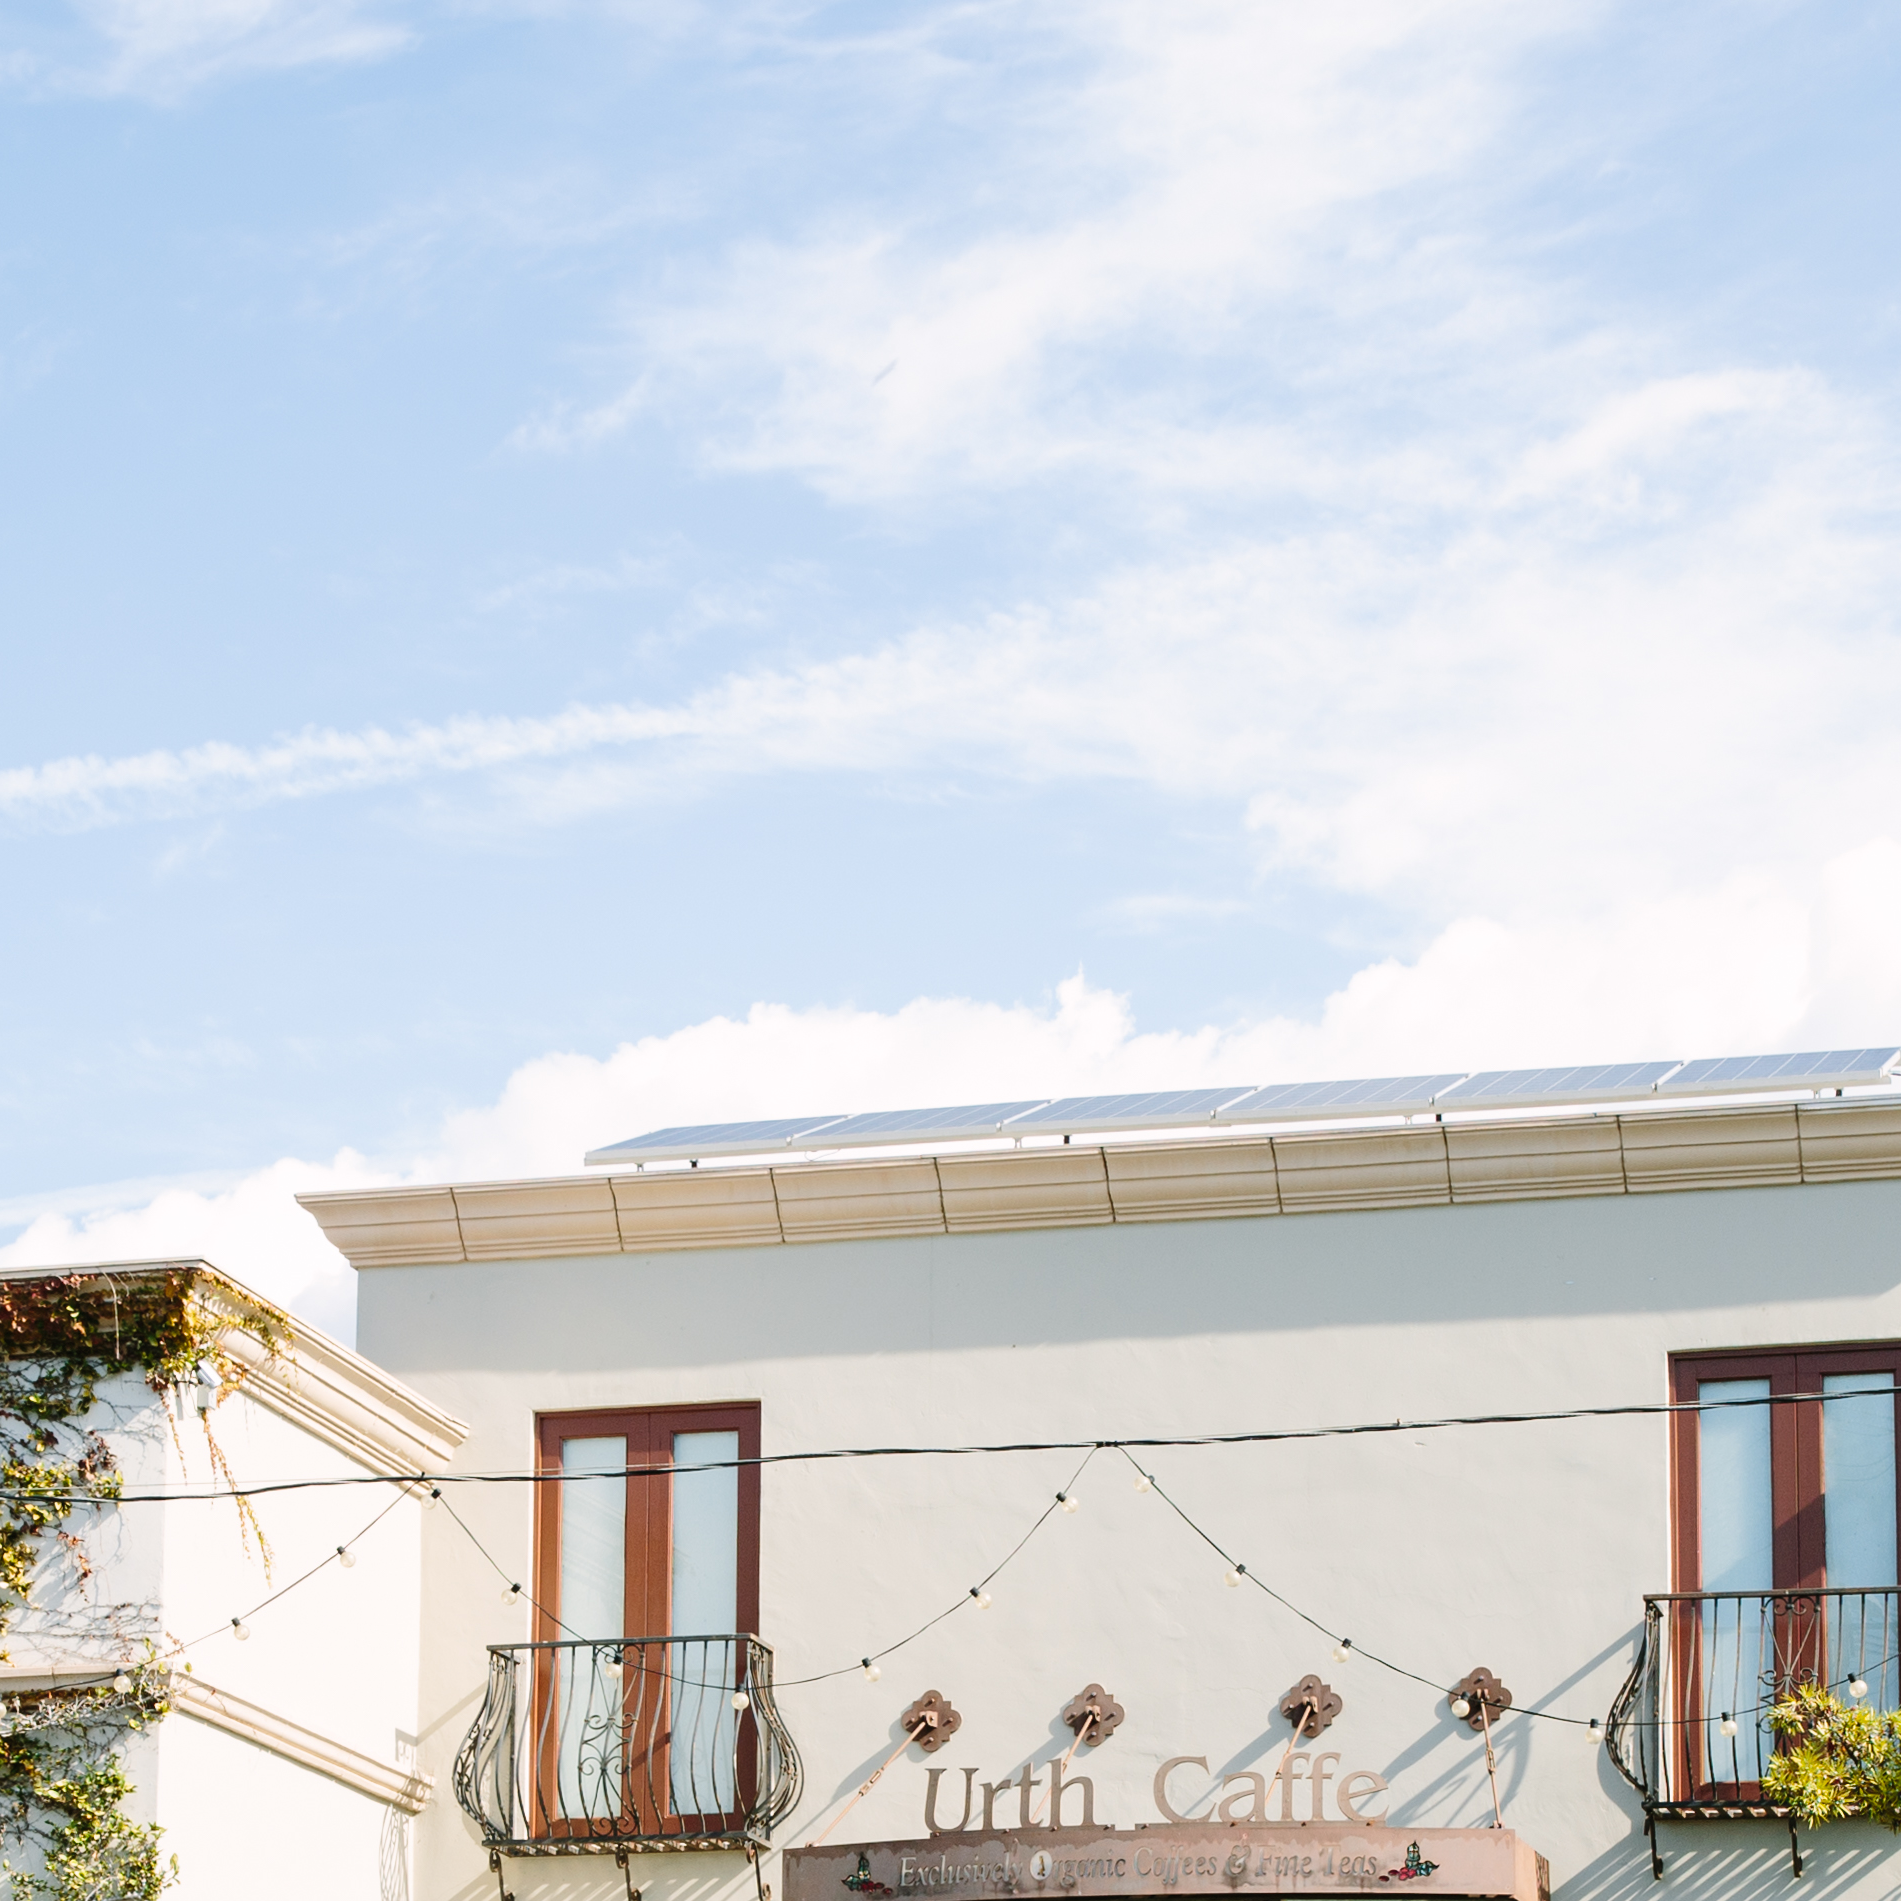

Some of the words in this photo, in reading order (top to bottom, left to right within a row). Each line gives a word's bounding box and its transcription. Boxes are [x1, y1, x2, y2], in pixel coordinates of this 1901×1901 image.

[924, 1758, 1097, 1831] Urth
[1153, 1752, 1389, 1822] Caffe
[900, 1852, 1024, 1887] Exclusively
[1030, 1849, 1126, 1888] Organic
[1133, 1845, 1217, 1885] Coffees
[1225, 1845, 1251, 1875] &
[1255, 1844, 1313, 1877] Fine
[1319, 1844, 1377, 1877] Teas
